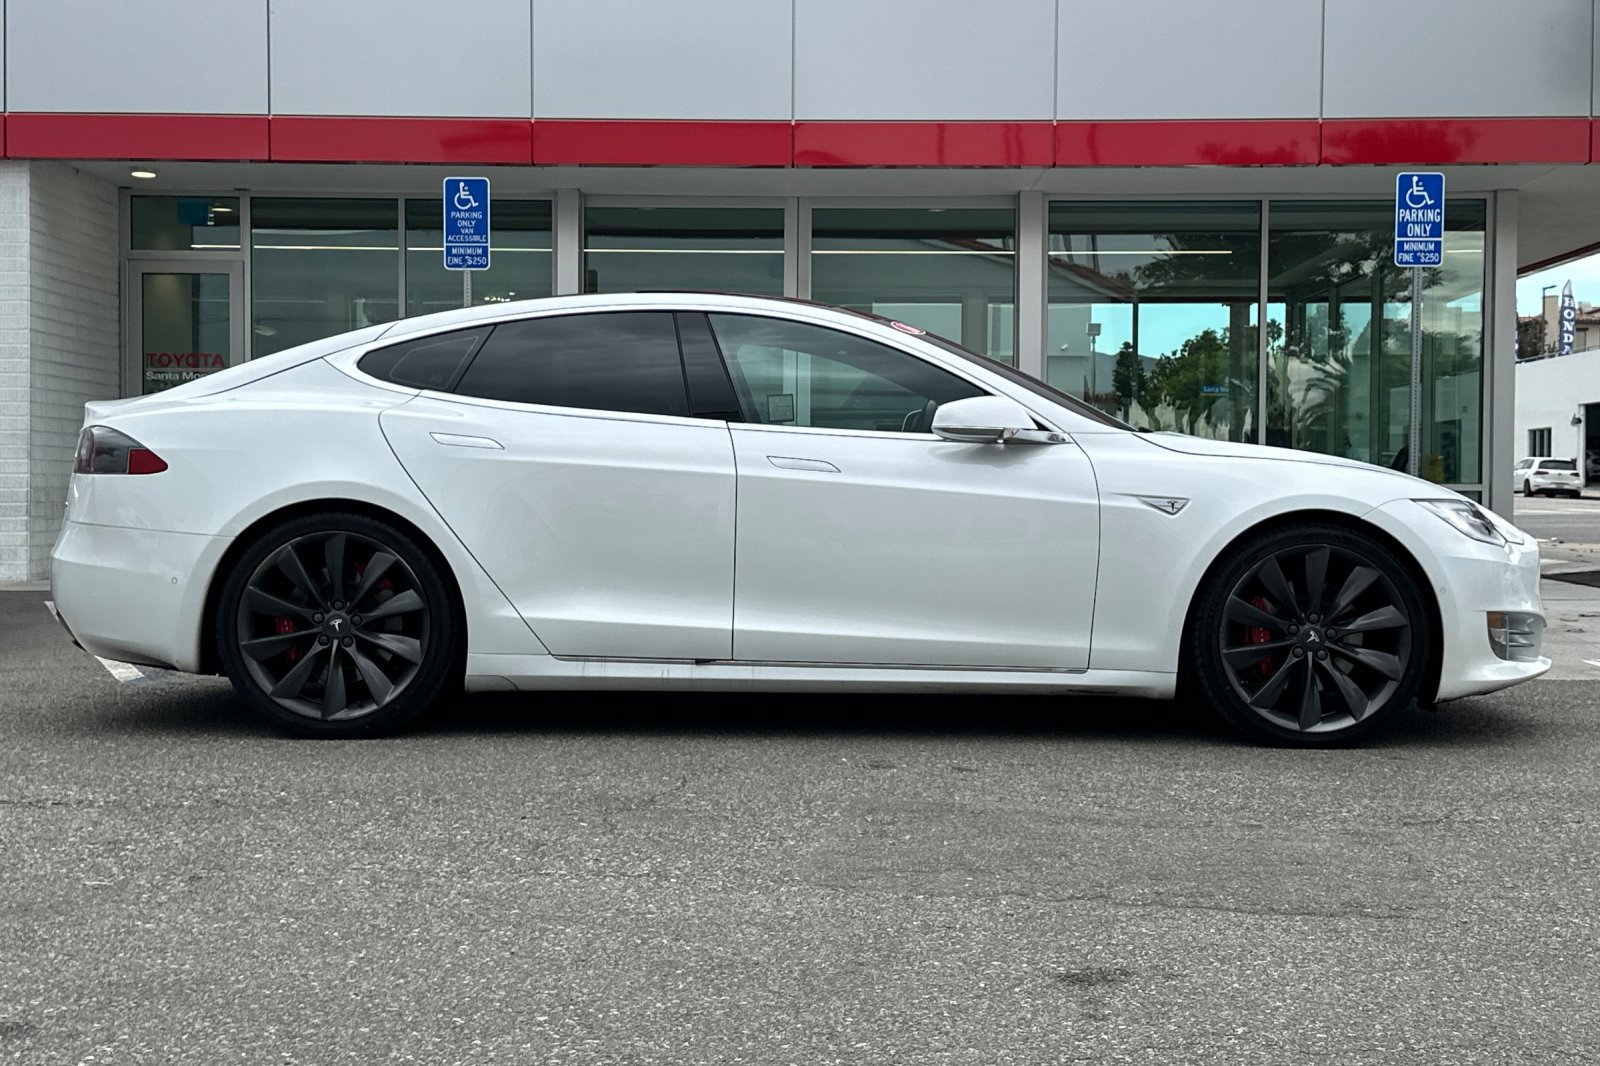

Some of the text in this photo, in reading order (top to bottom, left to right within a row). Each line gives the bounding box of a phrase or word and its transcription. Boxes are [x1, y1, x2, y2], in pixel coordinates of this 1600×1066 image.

[450, 211, 483, 219] PARKING
[1399, 208, 1441, 222] PARKING
[457, 219, 477, 227] ONLY
[1407, 223, 1432, 237] ONLY
[447, 234, 487, 242] ACCESSIBLE
[451, 246, 483, 255] MINIMUM
[1403, 241, 1435, 252] MINIMUM
[447, 256, 463, 265] FINE
[1398, 252, 1414, 262] FINE
[1562, 296, 1575, 355] HONDA
[146, 352, 225, 368] TOYOTA
[145, 371, 179, 380] Santa
